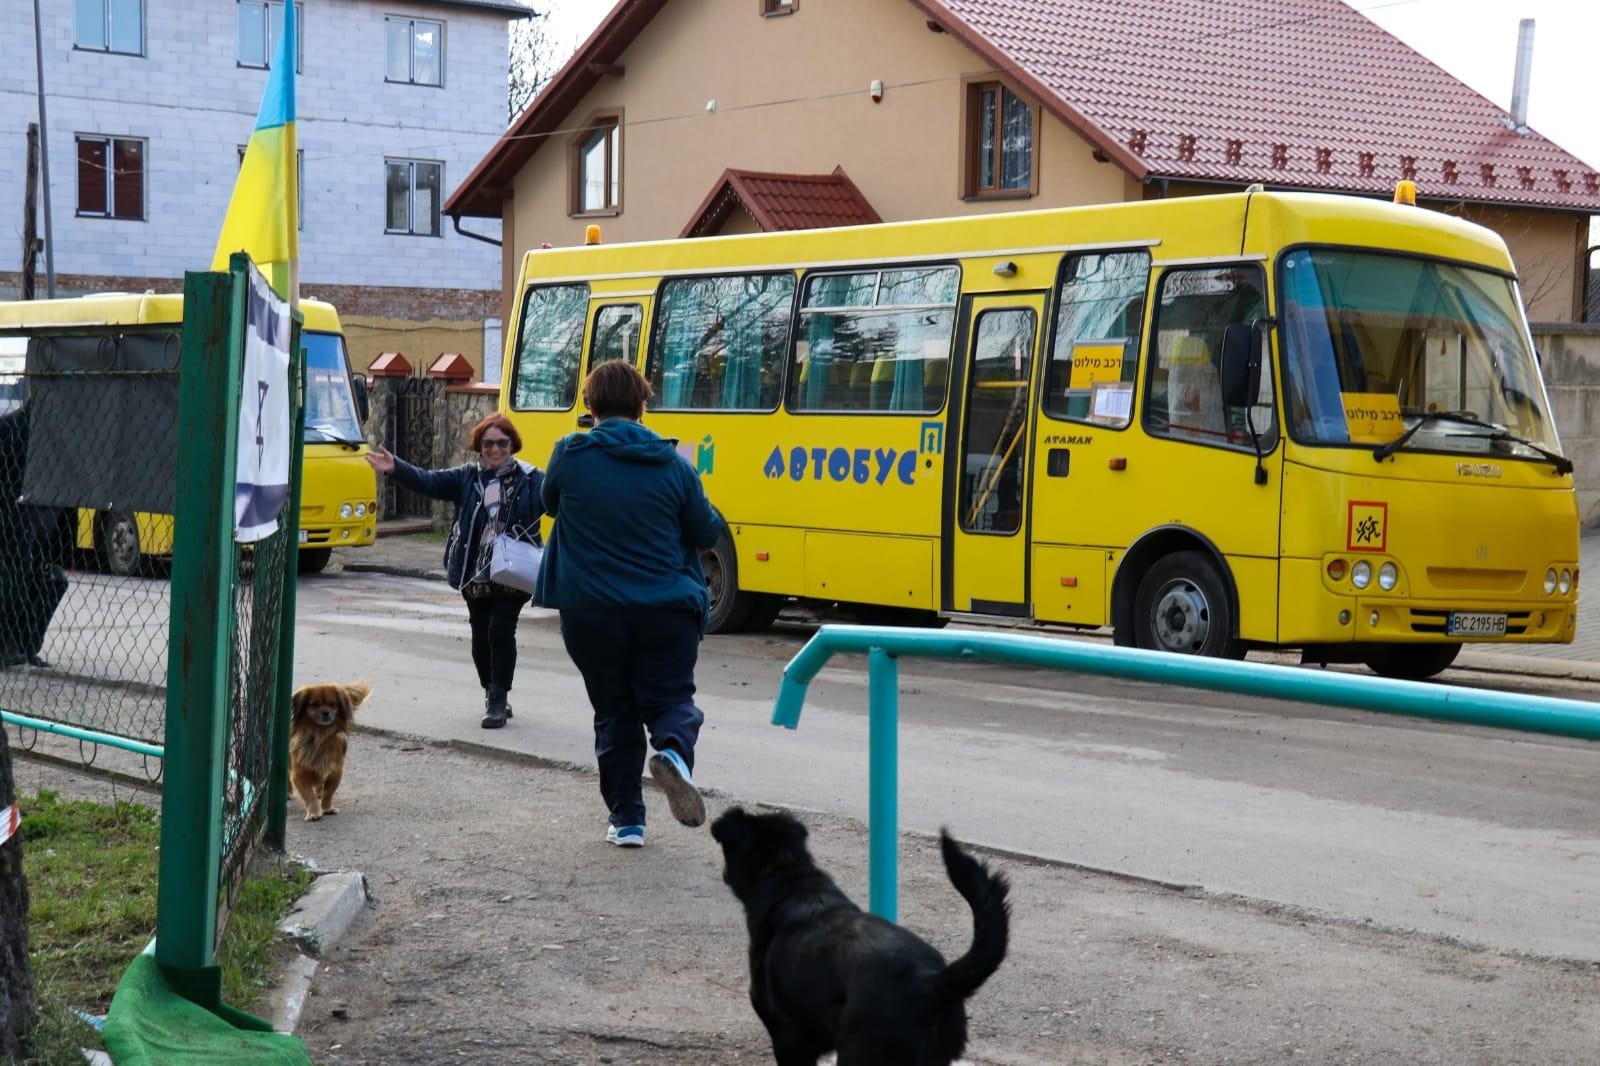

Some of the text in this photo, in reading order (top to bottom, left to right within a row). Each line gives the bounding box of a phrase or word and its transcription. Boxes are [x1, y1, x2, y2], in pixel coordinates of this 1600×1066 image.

[1074, 356, 1121, 369] רכב מילוט
[1346, 408, 1378, 420] מילוט
[1044, 435, 1093, 444] ATAMAN
[763, 444, 918, 486] АВТОБУС
[1454, 616, 1469, 631] BC
[1470, 616, 1491, 631] 2195
[1492, 616, 1505, 631] HB
